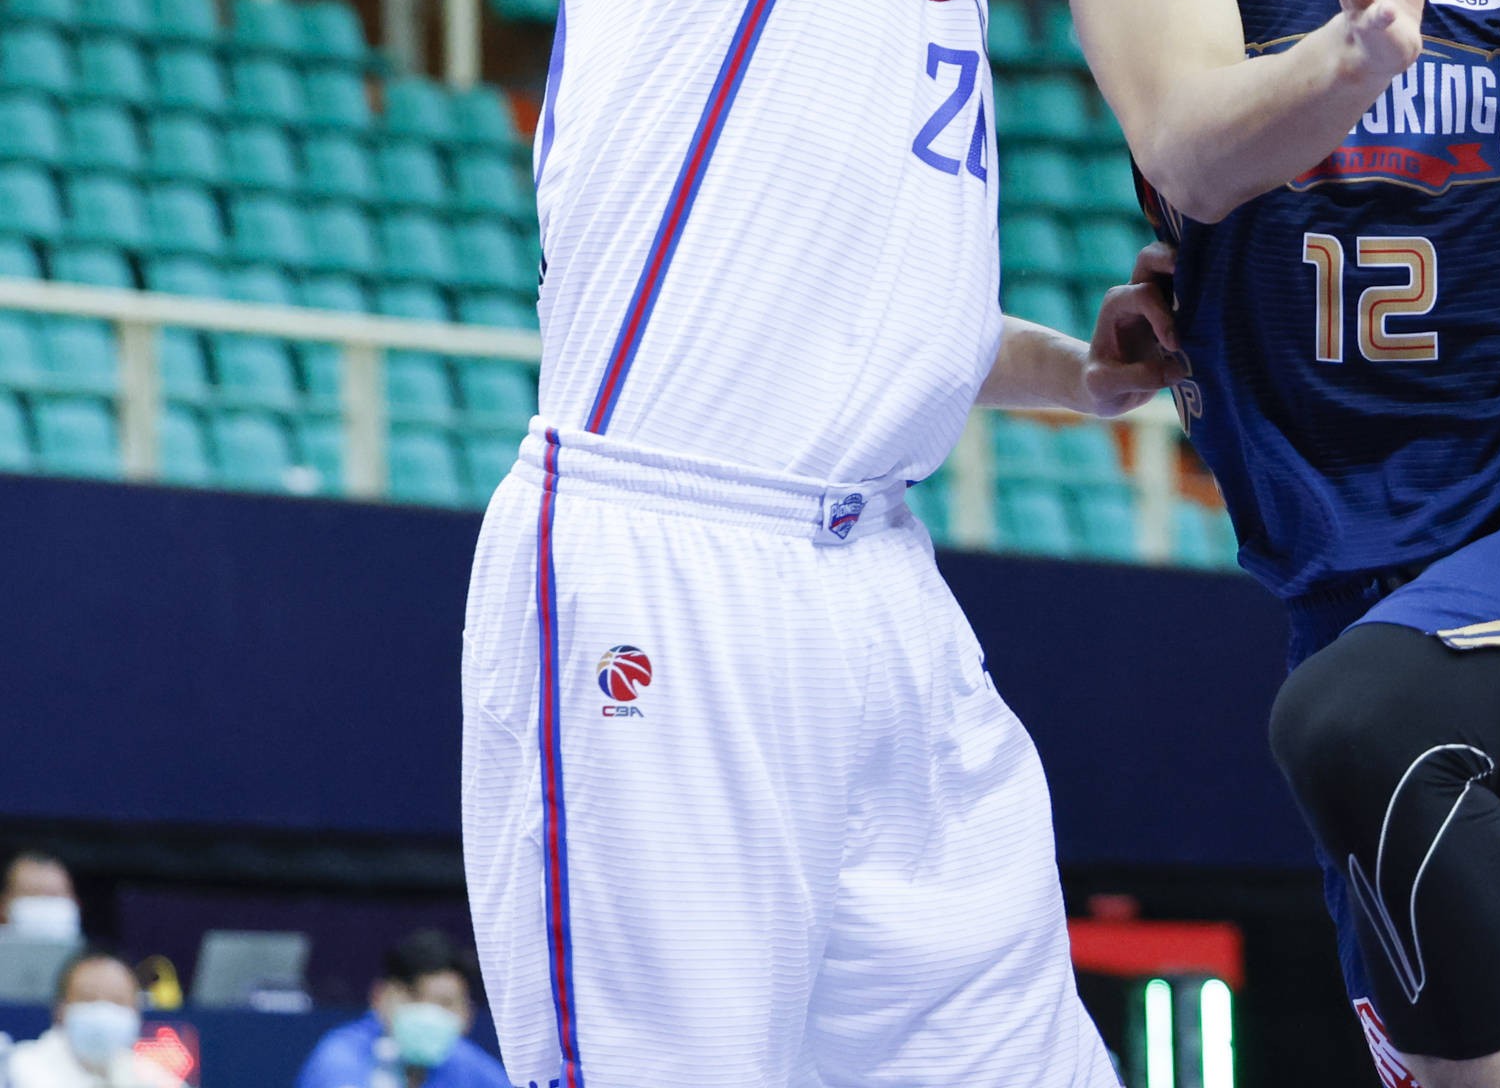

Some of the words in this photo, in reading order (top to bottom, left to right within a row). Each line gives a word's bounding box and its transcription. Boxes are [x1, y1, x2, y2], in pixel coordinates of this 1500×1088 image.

[1329, 151, 1421, 174] ANJING
[1302, 232, 1438, 362] 12
[602, 705, 645, 718] CBA
